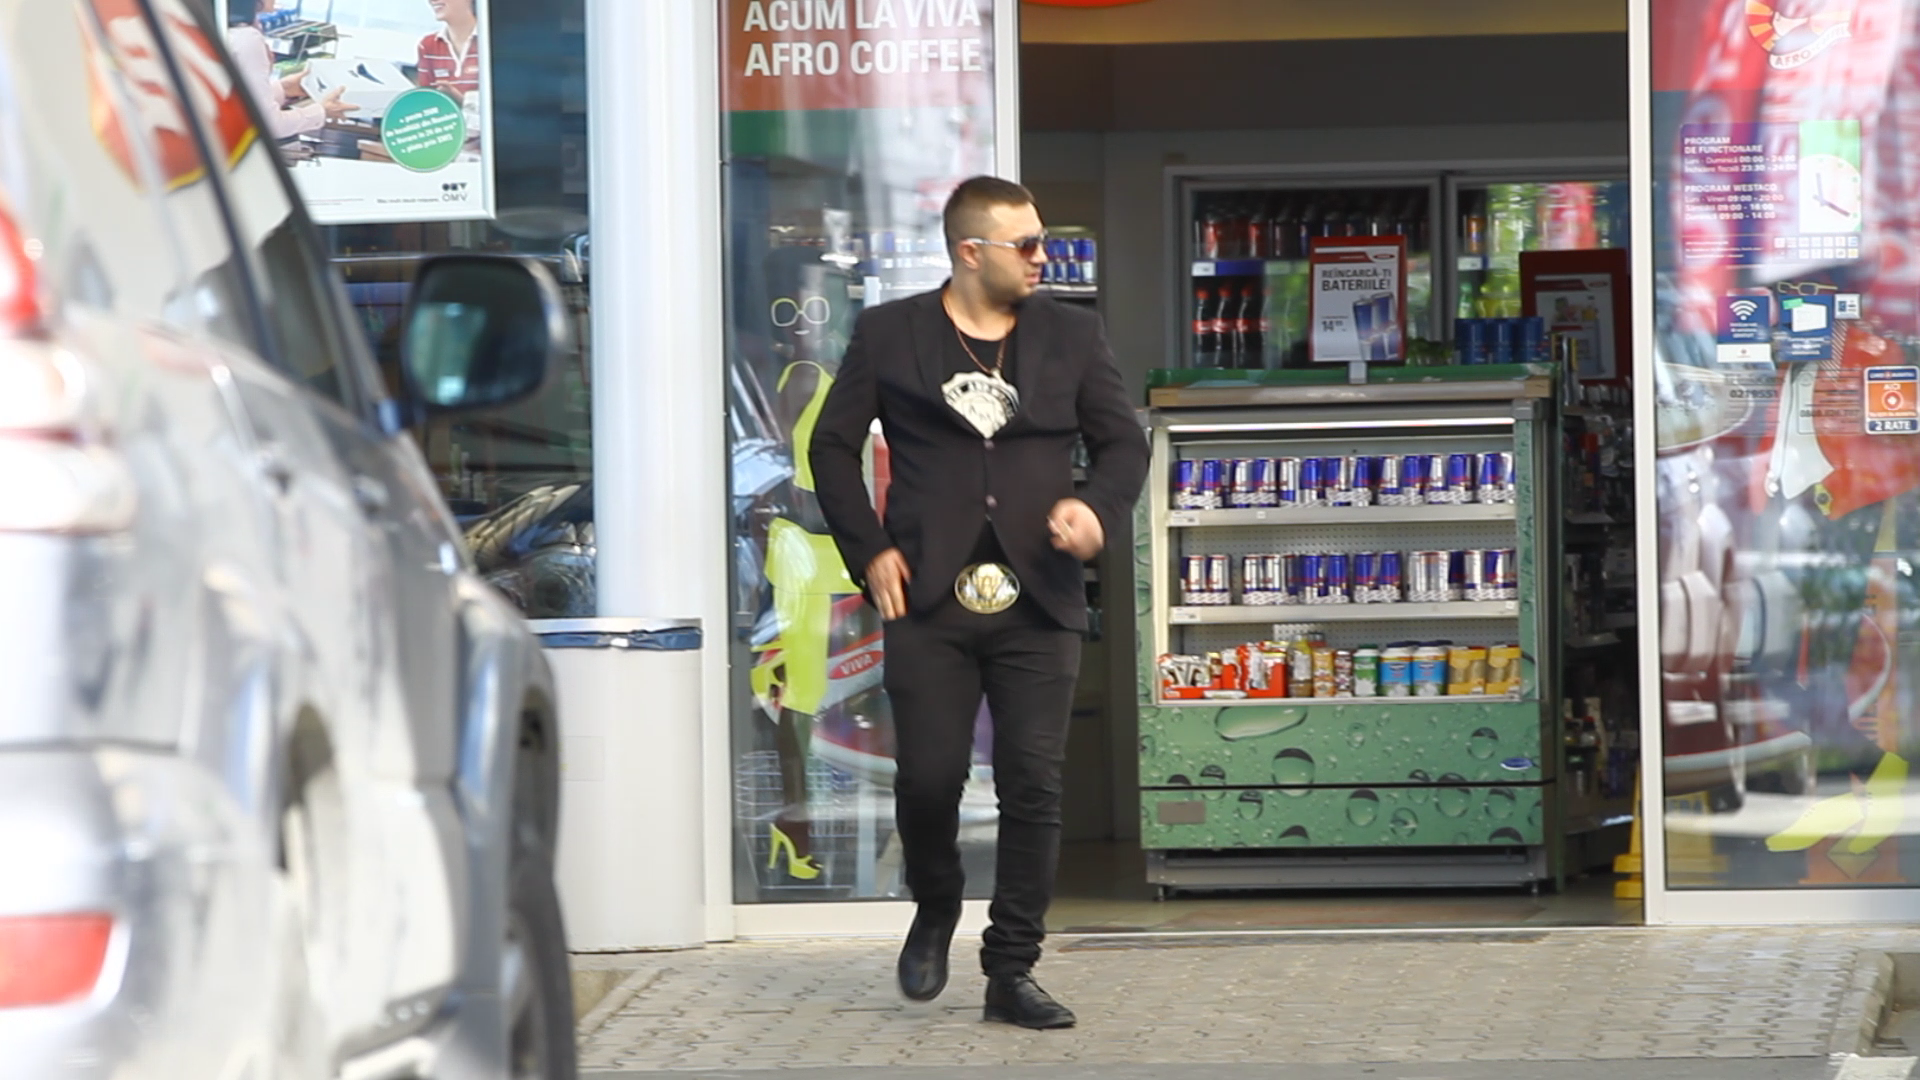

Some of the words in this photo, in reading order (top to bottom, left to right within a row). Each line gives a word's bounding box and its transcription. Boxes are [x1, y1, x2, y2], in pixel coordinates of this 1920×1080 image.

[743, 0, 846, 32] ACUM
[856, 0, 898, 30] LA
[903, 0, 982, 29] VIVA
[744, 40, 840, 77] AFRO
[850, 38, 983, 75] COFFEE
[1774, 49, 1811, 66] AFRO
[1684, 137, 1731, 145] PROGRAM
[1684, 146, 1697, 154] DE
[1684, 184, 1731, 192] PROGRAM
[442, 193, 467, 202] OMV
[1322, 280, 1391, 291] BATERIILE!
[1875, 421, 1883, 430] 2
[1884, 420, 1911, 430] RATE
[840, 653, 873, 675] VIVA
